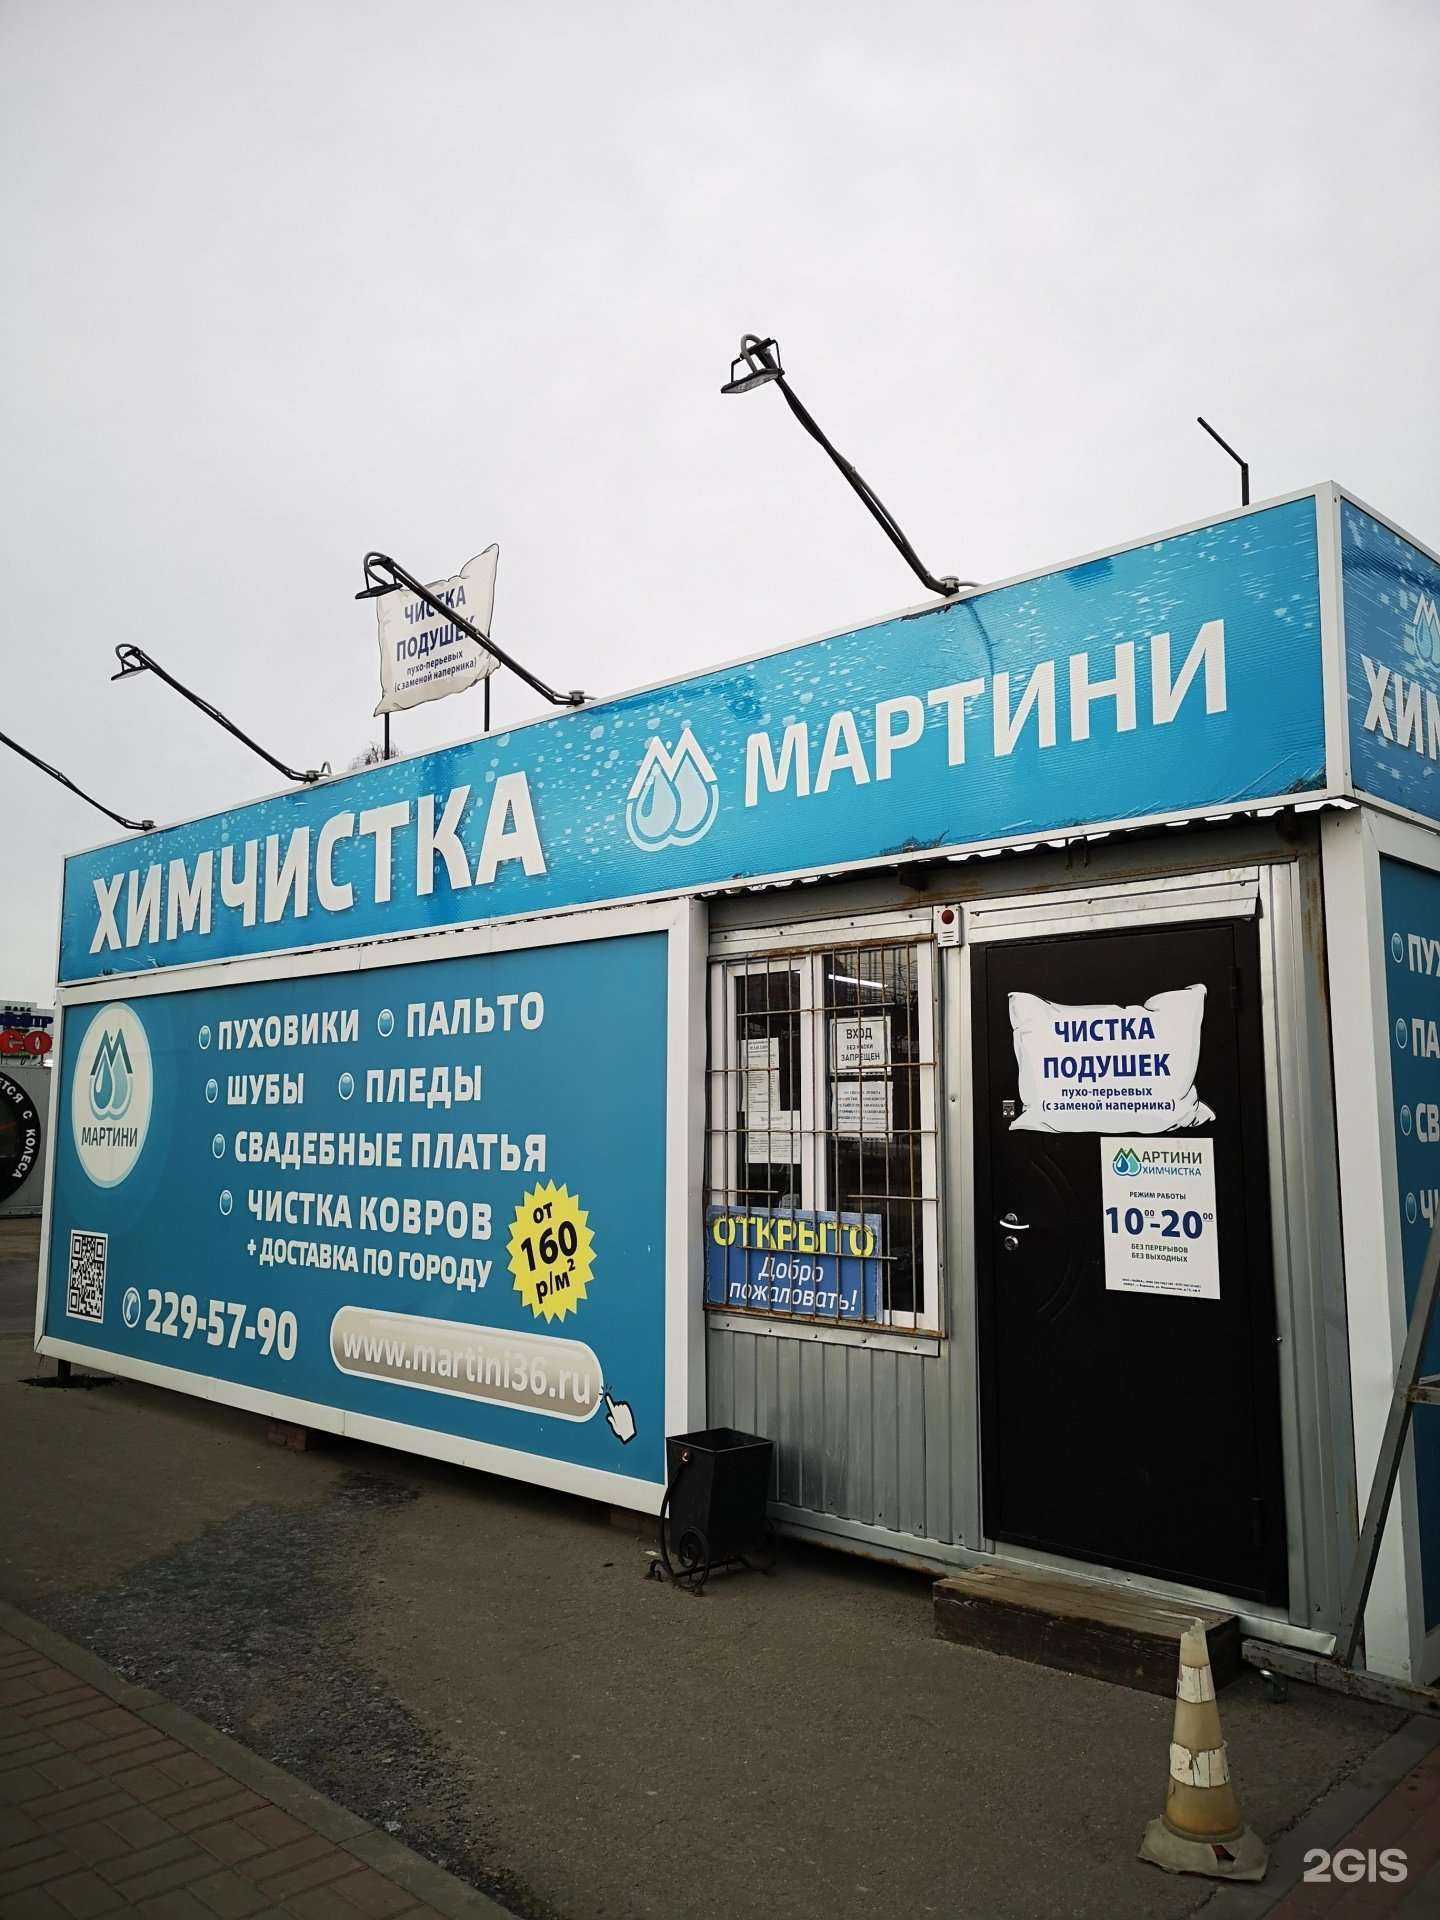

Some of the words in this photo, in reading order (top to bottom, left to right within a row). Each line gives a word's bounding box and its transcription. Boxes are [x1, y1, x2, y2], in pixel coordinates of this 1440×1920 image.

[401, 671, 433, 690] заменой
[433, 657, 477, 680] наперника)
[407, 651, 463, 677] пухо-перьевых
[744, 619, 1227, 807] МАРТИНИ
[89, 771, 548, 954] ХИМЧИСТКА
[218, 1009, 359, 1050] ПУХОВИКИ
[407, 991, 545, 1037] ПАЛЬТО
[1054, 1017, 1156, 1042] ЧИСТКА
[1043, 1054, 1171, 1083] ПОДУШЕК
[227, 1073, 304, 1105] ШУБЫ
[366, 1065, 482, 1109] ПЛЕДЫ
[1061, 1087, 1153, 1099] пухо-перьевых
[1053, 1100, 1103, 1111] заменой
[1105, 1100, 1176, 1112] наперника)
[12, 1128, 36, 1178] КОЛЕСА
[81, 1127, 138, 1147] МАРТИНИ
[234, 1131, 403, 1170] СВАДЕБНЫЕ
[412, 1133, 547, 1172] ПЛАТЬЯ
[1142, 1165, 1202, 1176] ХИМЧИСТКА
[1129, 1191, 1155, 1199] РЕЖИМ
[1156, 1192, 1186, 1200] РАБОТЫ
[248, 1189, 352, 1228] ЧИСТКА
[360, 1196, 492, 1240] КОВРОВ
[521, 1220, 578, 1272] 160
[713, 1216, 874, 1256] ОТКРЫТО
[1145, 1244, 1188, 1253] ПЕРЕРЫВОВ
[259, 1237, 359, 1273] ДОСТАВКА
[363, 1247, 393, 1277] ПО
[398, 1251, 493, 1293] ГОРОДУ
[758, 1257, 824, 1285] Добро
[1145, 1253, 1188, 1262] ВЫХОДНЫХ
[729, 1282, 858, 1311] пожаловать!
[145, 1288, 298, 1361] 229-57-90
[343, 1332, 591, 1405] www.martini36.ru
